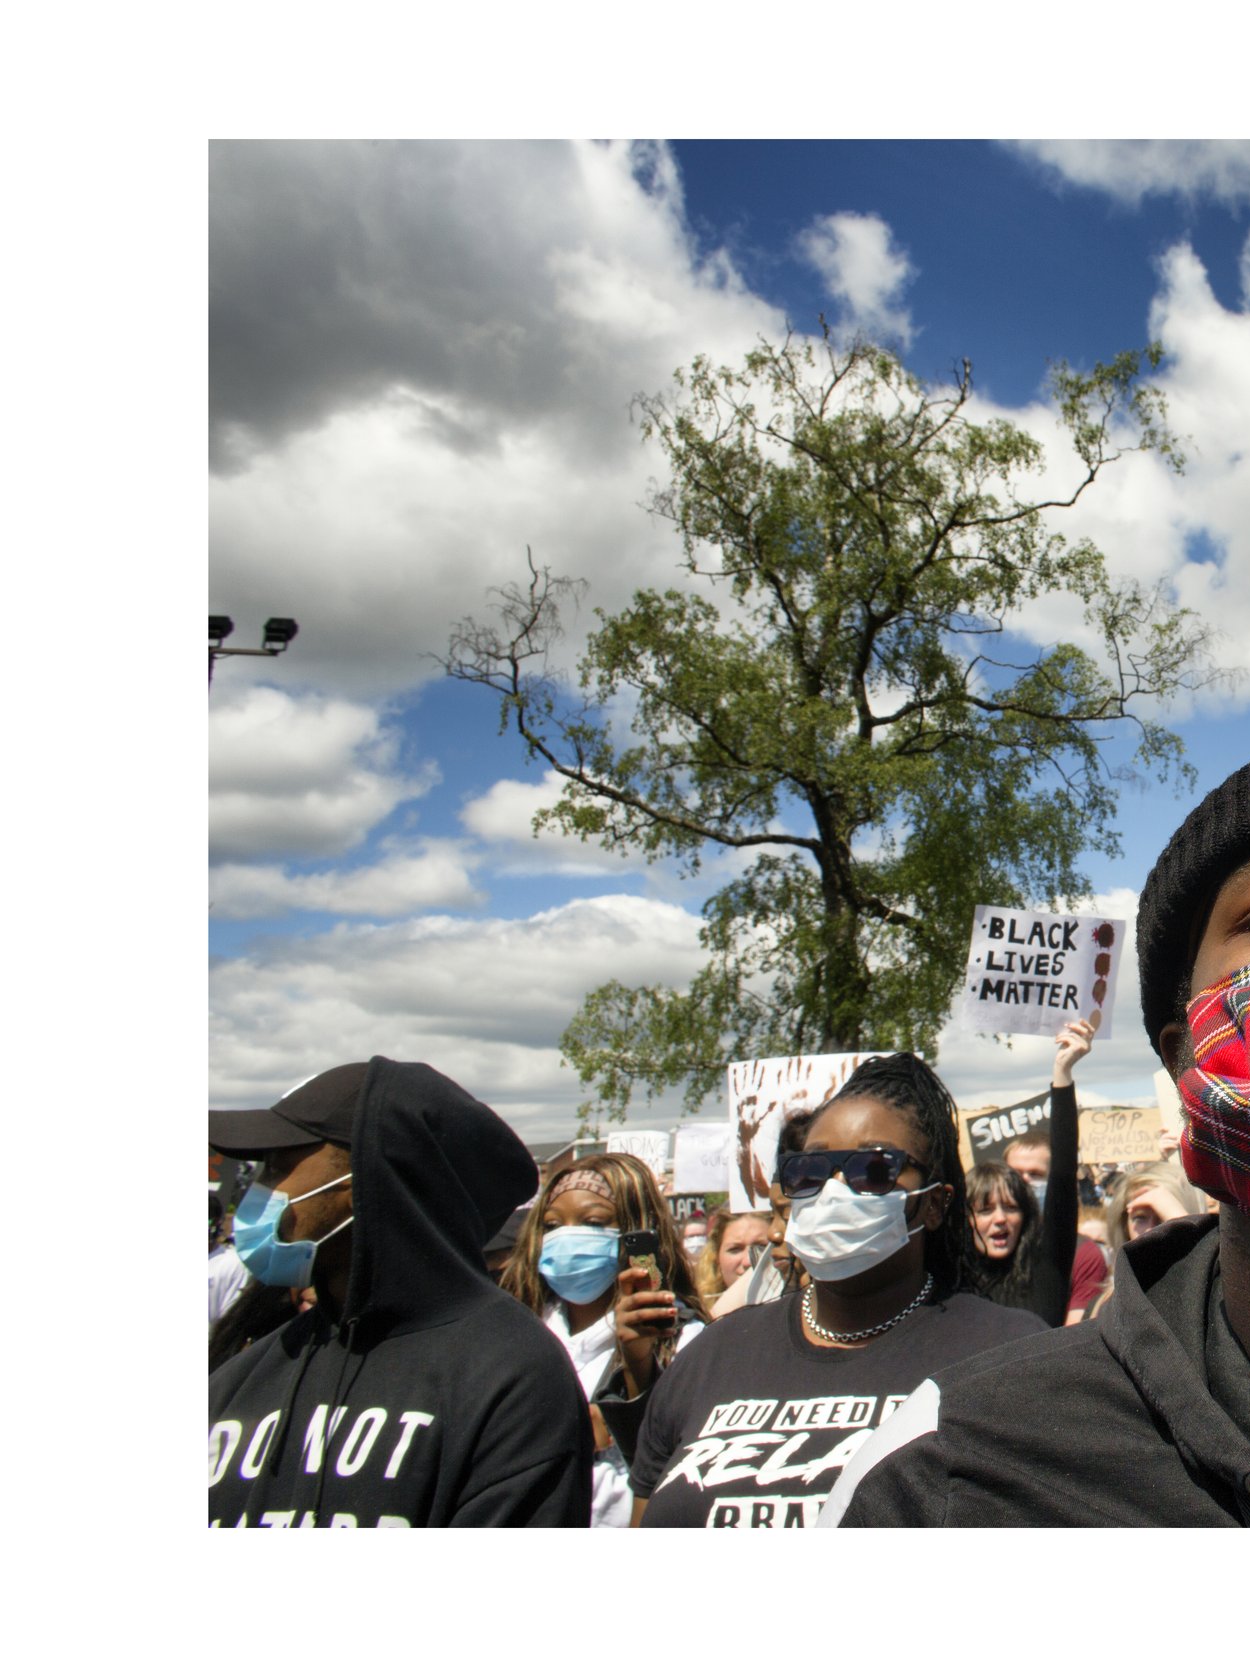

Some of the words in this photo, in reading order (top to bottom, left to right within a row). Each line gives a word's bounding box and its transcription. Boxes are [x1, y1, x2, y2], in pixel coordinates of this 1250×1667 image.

[988, 916, 1079, 951] BLACK
[985, 950, 1066, 976] LIVES
[979, 977, 1079, 1010] MATTER
[1091, 1111, 1144, 1134] STOP
[712, 1404, 772, 1431] YOU
[779, 1401, 870, 1427] NEED
[208, 1409, 282, 1489] DO
[301, 1404, 435, 1479] NOT
